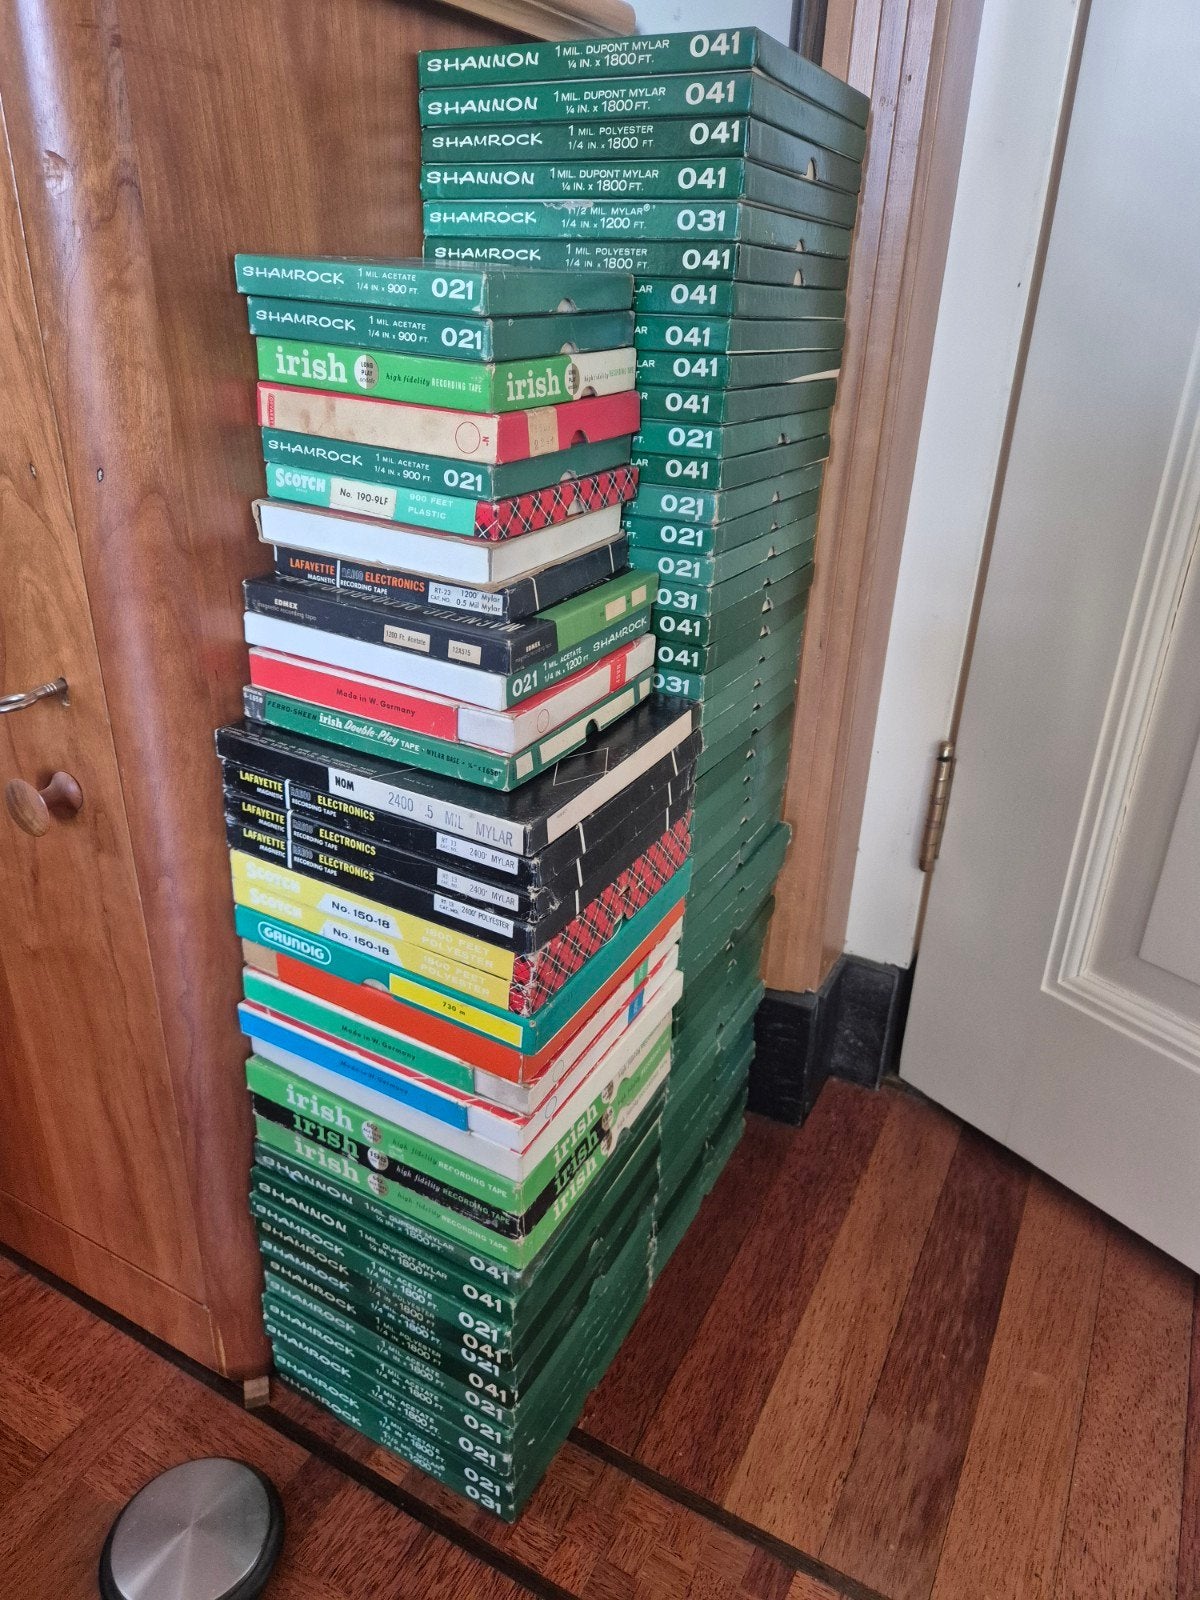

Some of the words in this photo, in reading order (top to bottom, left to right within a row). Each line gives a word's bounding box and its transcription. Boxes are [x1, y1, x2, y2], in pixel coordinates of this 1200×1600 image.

[563, 45, 582, 56] MIL.
[586, 42, 629, 54] DUPONT
[632, 39, 669, 51] MYLAR
[690, 32, 740, 57] 041
[427, 52, 539, 72] SHANNON
[579, 59, 592, 68] IN.
[605, 53, 636, 66] 1800
[638, 52, 654, 64] FT.
[584, 90, 626, 100] DUPONT
[629, 87, 666, 97] MYLAR
[686, 80, 736, 105] 041
[428, 97, 538, 115] SHANNON
[601, 100, 632, 112] 1800
[432, 132, 542, 148] SHAMROCK
[599, 126, 653, 135] POLYESTER
[690, 121, 739, 145] 041
[568, 140, 584, 149] 1/4
[607, 137, 638, 149] 1800
[427, 171, 534, 185] SHANNON
[580, 169, 620, 178] DUPONT
[623, 169, 659, 178] MYLAR
[678, 167, 725, 190] 041
[596, 179, 627, 191] 1800
[629, 181, 644, 190] FT.
[430, 211, 536, 223] SHAMROCK
[590, 207, 608, 215] MIL
[677, 209, 724, 231] 031
[561, 219, 577, 228] 1/4
[600, 217, 630, 228] 1200
[435, 247, 541, 260] SHAMROCK
[596, 247, 647, 256] POLYESTER
[682, 249, 730, 270] 041
[566, 259, 581, 267] 1/4
[603, 257, 632, 269] 1800
[243, 266, 344, 284] SHAMROCK
[382, 272, 416, 281] ACETATE
[388, 284, 406, 294] 900
[432, 278, 473, 300] 021
[671, 284, 716, 304] 041
[256, 310, 355, 331] SHAMROCK
[392, 321, 426, 330] ACETATE
[398, 333, 417, 342] 900
[441, 327, 481, 350] 021
[665, 326, 710, 346] 041
[276, 346, 347, 383] irish
[673, 358, 717, 377] 041
[386, 373, 401, 381] high
[403, 376, 430, 387] fidelity
[432, 378, 465, 390] RECORDING
[469, 383, 482, 393] TAPE
[507, 368, 561, 401] irish
[665, 393, 709, 413] 041
[668, 428, 712, 449] 021
[268, 440, 362, 466] SHAMROCK
[398, 460, 430, 470] ACETATE
[403, 470, 421, 480] 900
[666, 460, 708, 479] 041
[275, 468, 325, 492] SCOTCH
[444, 470, 482, 491] 021
[340, 488, 352, 498] No.
[357, 489, 389, 505] 190-9LF
[430, 496, 453, 506] FEET
[661, 495, 703, 516] 021
[408, 507, 446, 519] PLASTIC
[660, 525, 703, 546] 021
[290, 557, 335, 575] LAFAYETTE
[365, 571, 424, 592] ELECTRONICS
[658, 557, 700, 578] 021
[307, 573, 335, 584] MAGNETIC
[340, 580, 372, 593] RECORDING
[373, 587, 387, 595] TAPE
[275, 599, 297, 609] EDMEX
[481, 604, 500, 612] Mylar
[656, 589, 698, 610] 031
[593, 616, 647, 651] SHAMROCK
[660, 616, 699, 636] 041
[560, 647, 582, 662] ACETATE
[566, 656, 582, 670] 1200
[658, 647, 698, 667] 041
[513, 670, 537, 697] 021
[336, 689, 357, 700] Made
[369, 697, 378, 706] W.
[381, 701, 415, 717] Germany
[268, 701, 316, 720] FERRO-SHEEN
[319, 713, 342, 728] irish
[344, 720, 399, 746] Double-Play
[401, 741, 420, 752] TAPE
[240, 771, 282, 792] LAFAYETTE
[317, 795, 375, 821] ELECTRONICS
[292, 798, 321, 813] RECORDING
[335, 776, 354, 791] NOM
[388, 792, 413, 811] 2400
[476, 822, 513, 847] MYLAR
[242, 802, 285, 824] LAFAYETTE
[319, 829, 376, 855] ELECTRONICS
[243, 828, 285, 850] LAFAYETTE
[319, 855, 374, 881] ELECTRONICS
[492, 855, 514, 869] MYLAR
[492, 892, 514, 906] MYLAR
[332, 901, 350, 915] No.
[353, 910, 390, 930] 150-18
[263, 927, 325, 961] GRUNDIG
[333, 927, 351, 941] No.
[442, 1002, 456, 1011] 730
[286, 1084, 353, 1132] irish
[293, 1114, 359, 1163] irish
[294, 1138, 360, 1183] irish
[262, 1156, 353, 1205] SHANNON
[259, 1183, 347, 1233] SHANNON
[256, 1204, 344, 1257] SHAMROCK
[262, 1221, 349, 1275] SHAMROCK
[470, 1256, 508, 1285] 041
[270, 1261, 356, 1314] SHAMROCK
[270, 1281, 355, 1334] SHAMROCK
[463, 1284, 502, 1313] 041
[270, 1305, 355, 1358] SHAMROCK
[458, 1312, 498, 1343] 021
[266, 1324, 351, 1378] SHAMROCK
[277, 1355, 359, 1409] SHAMROCK
[469, 1373, 506, 1403] 041
[465, 1391, 503, 1420] 021
[464, 1415, 501, 1444] 021
[459, 1437, 496, 1467] 021
[464, 1467, 500, 1496] 021
[465, 1485, 501, 1514] 031
